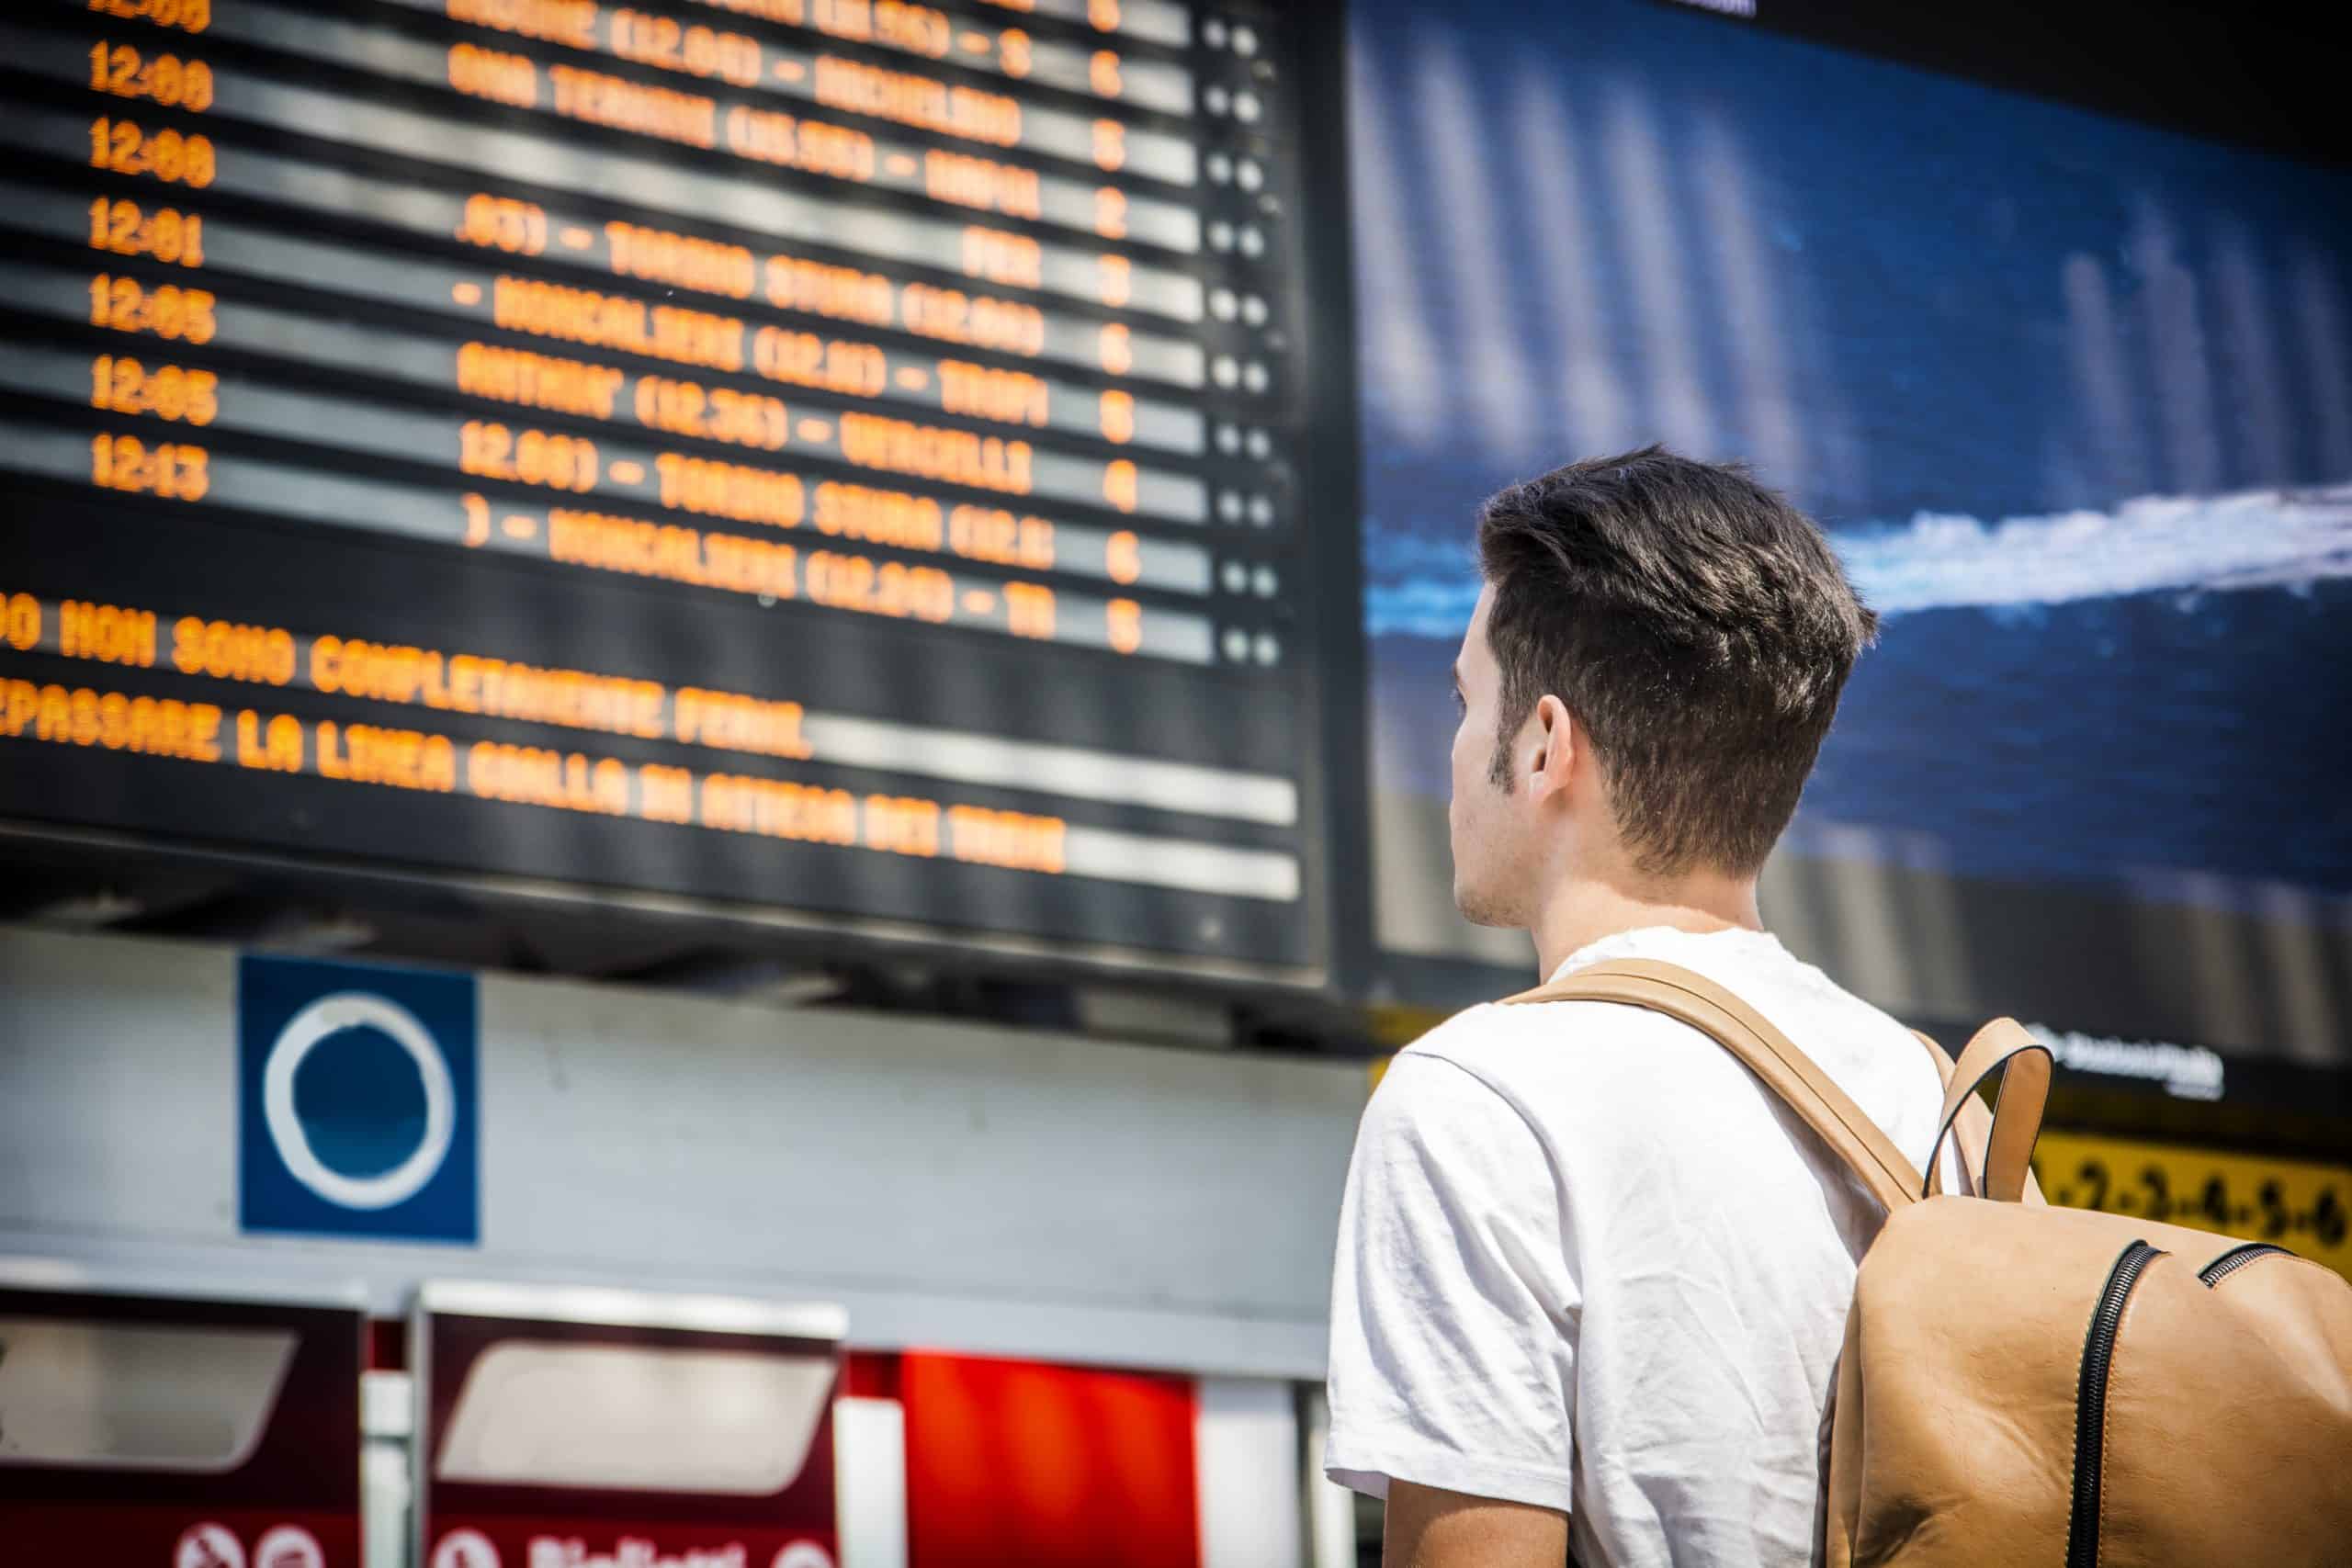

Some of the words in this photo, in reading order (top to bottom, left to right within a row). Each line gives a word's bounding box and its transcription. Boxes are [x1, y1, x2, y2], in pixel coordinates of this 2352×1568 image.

[59, 599, 157, 668] NON
[171, 616, 298, 686] SONO
[309, 635, 666, 740] COMPLETAMENTE
[236, 708, 305, 773] LA
[315, 719, 457, 794] LINEA
